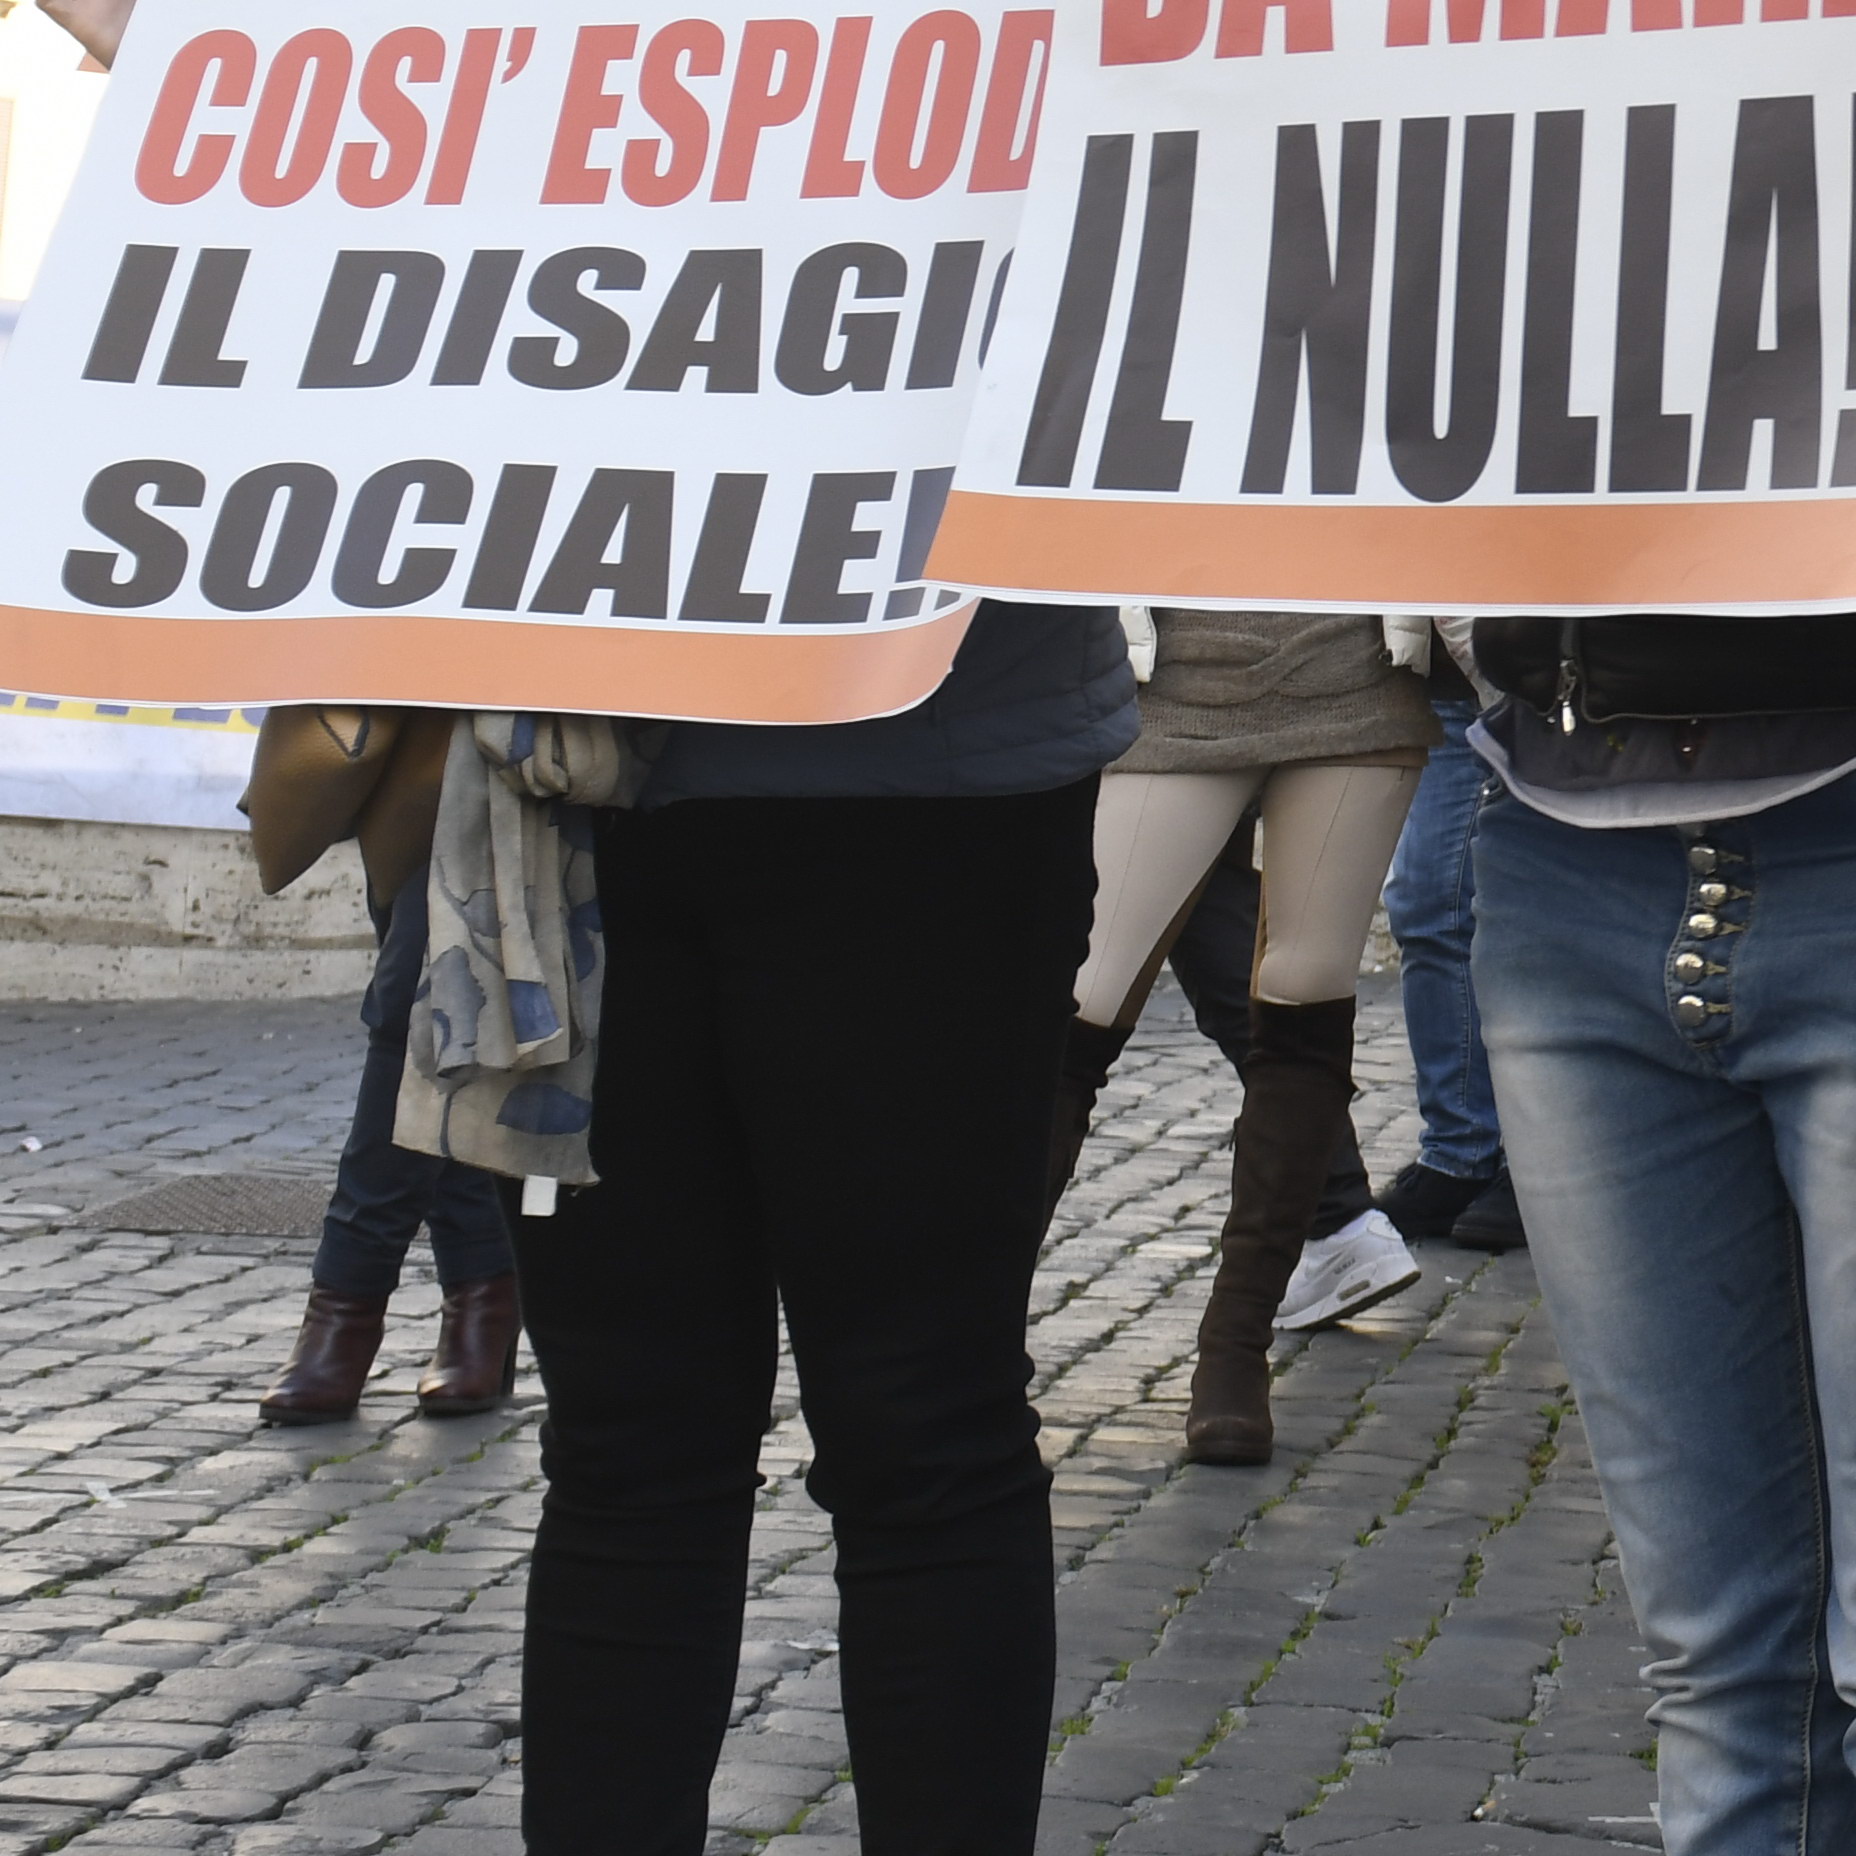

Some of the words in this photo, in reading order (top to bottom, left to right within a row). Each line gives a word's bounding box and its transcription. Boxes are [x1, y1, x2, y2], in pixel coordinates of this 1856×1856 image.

[135, 26, 535, 209] COSI'
[540, 10, 1054, 207] ESPLOD
[82, 244, 250, 388] IL
[298, 240, 1015, 396] DISAGI
[1016, 130, 1199, 492] IL
[62, 458, 961, 625] SOCIALE!
